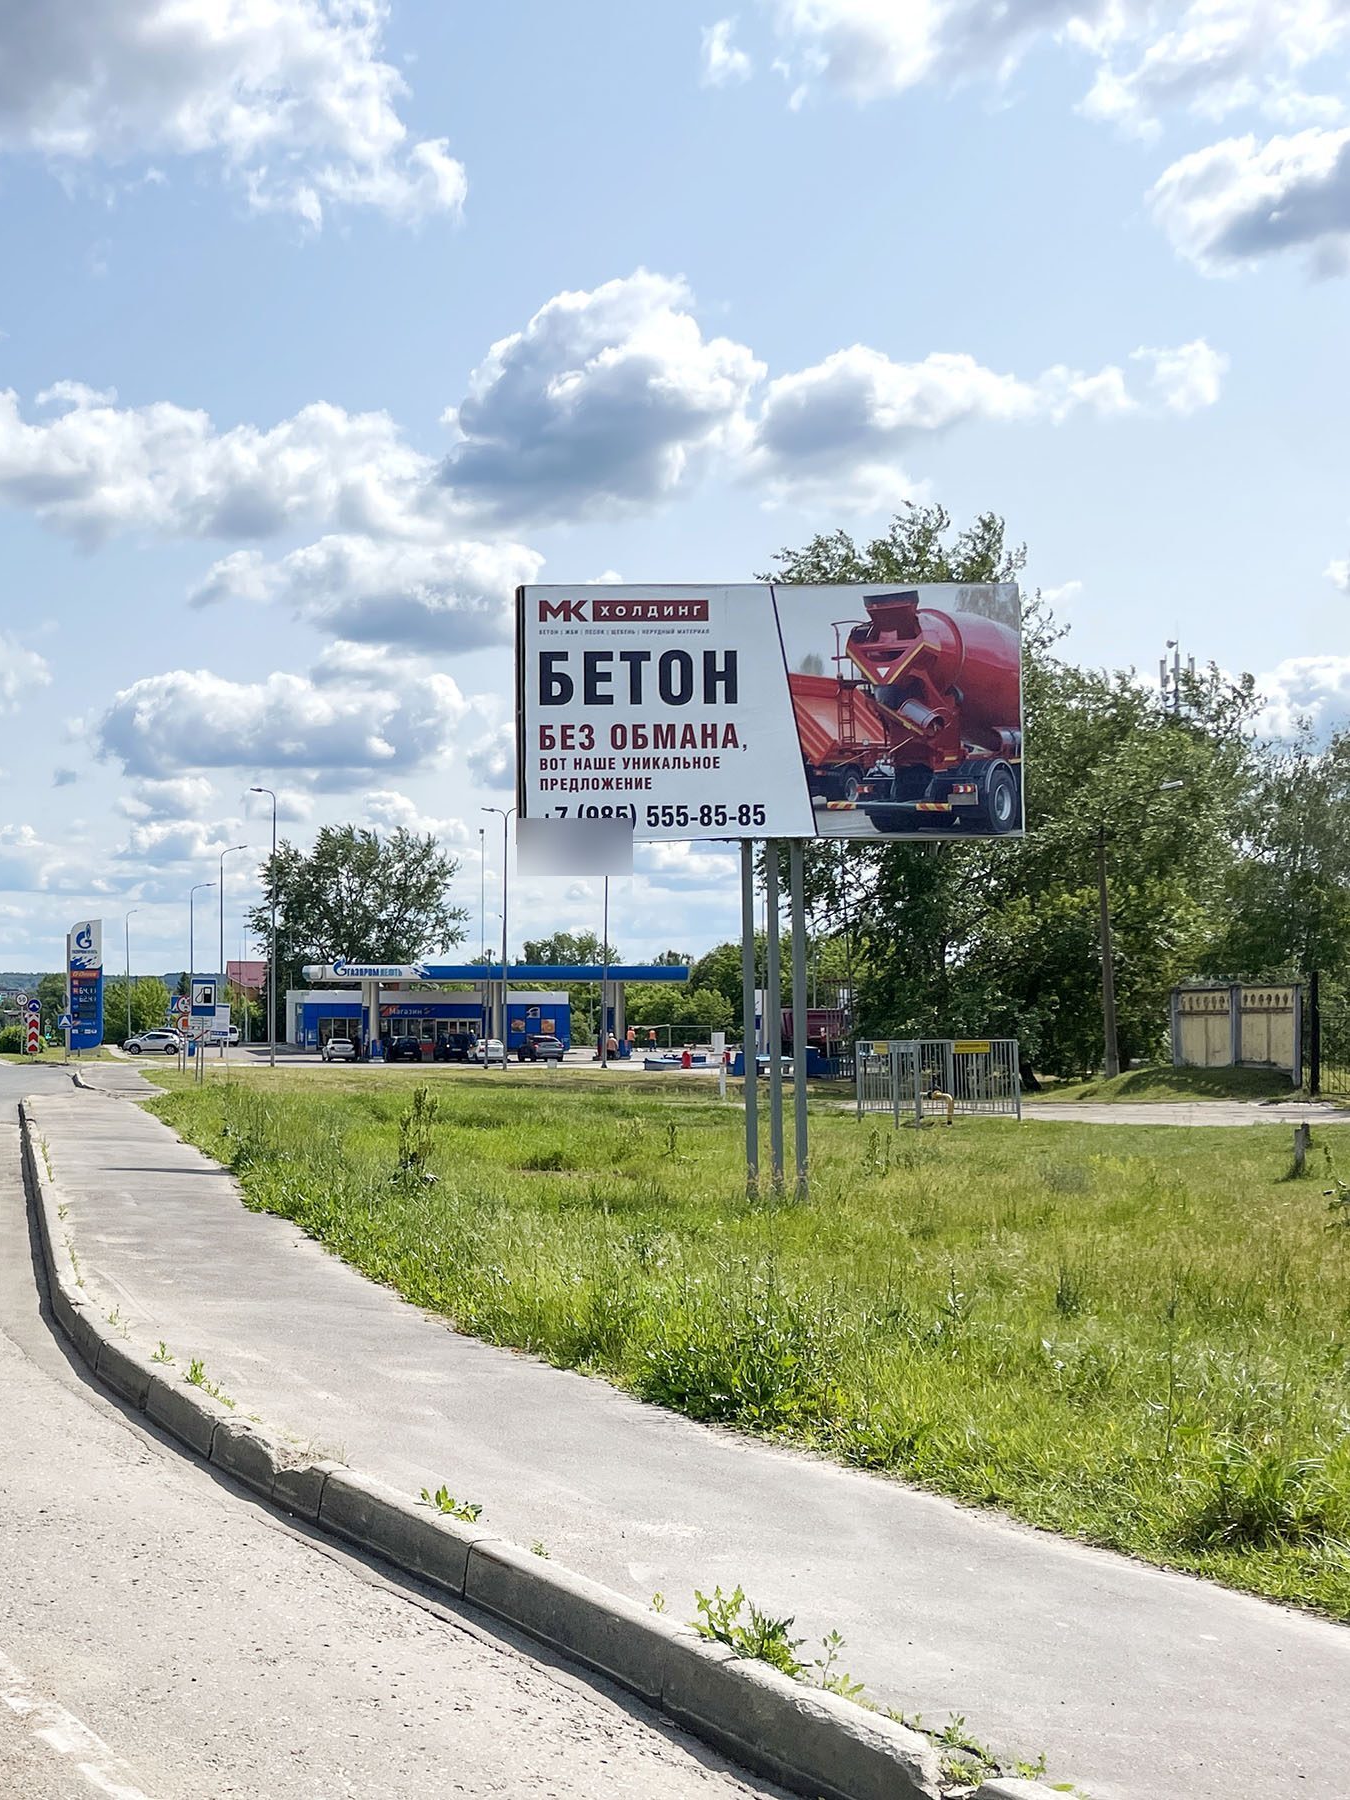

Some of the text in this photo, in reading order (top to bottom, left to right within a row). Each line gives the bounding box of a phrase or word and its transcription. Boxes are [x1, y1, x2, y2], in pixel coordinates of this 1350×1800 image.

[539, 600, 702, 622] МК ХОЛДИНГ
[539, 650, 738, 706] БЕТОН
[539, 723, 748, 751] БЕЗ ОБМАНА,
[539, 756, 721, 771] ВОТ НАШЕ УНИКАЛЬНОЕ
[539, 777, 652, 793] ПРЕДЛОЖЕНИЕ
[646, 804, 766, 827] 555-85-85
